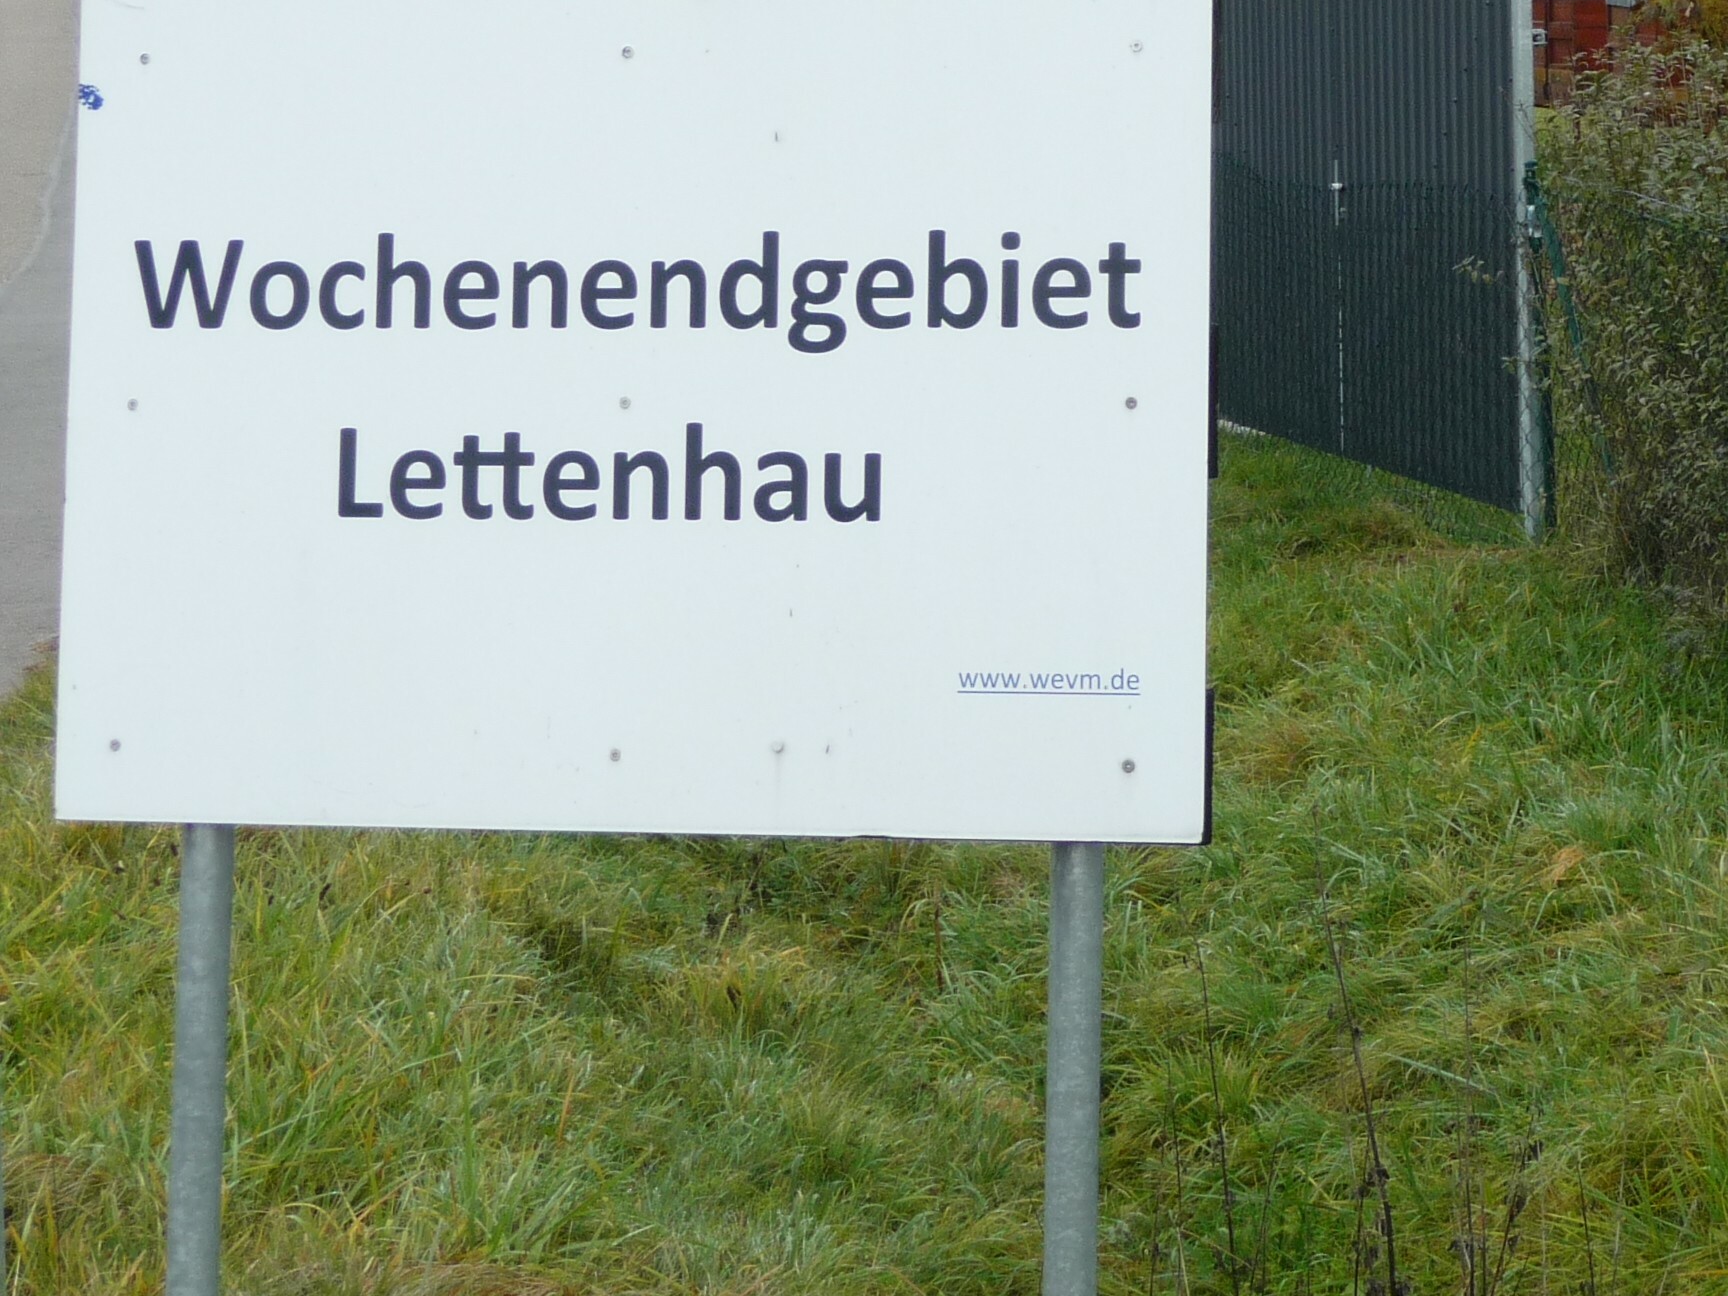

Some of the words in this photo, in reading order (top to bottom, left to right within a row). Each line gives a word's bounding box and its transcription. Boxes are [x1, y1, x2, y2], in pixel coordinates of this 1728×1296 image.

[134, 229, 1142, 353] Wochenendgebiet
[337, 422, 882, 522] Lettenhau
[957, 667, 1141, 691] www.wevm.de
